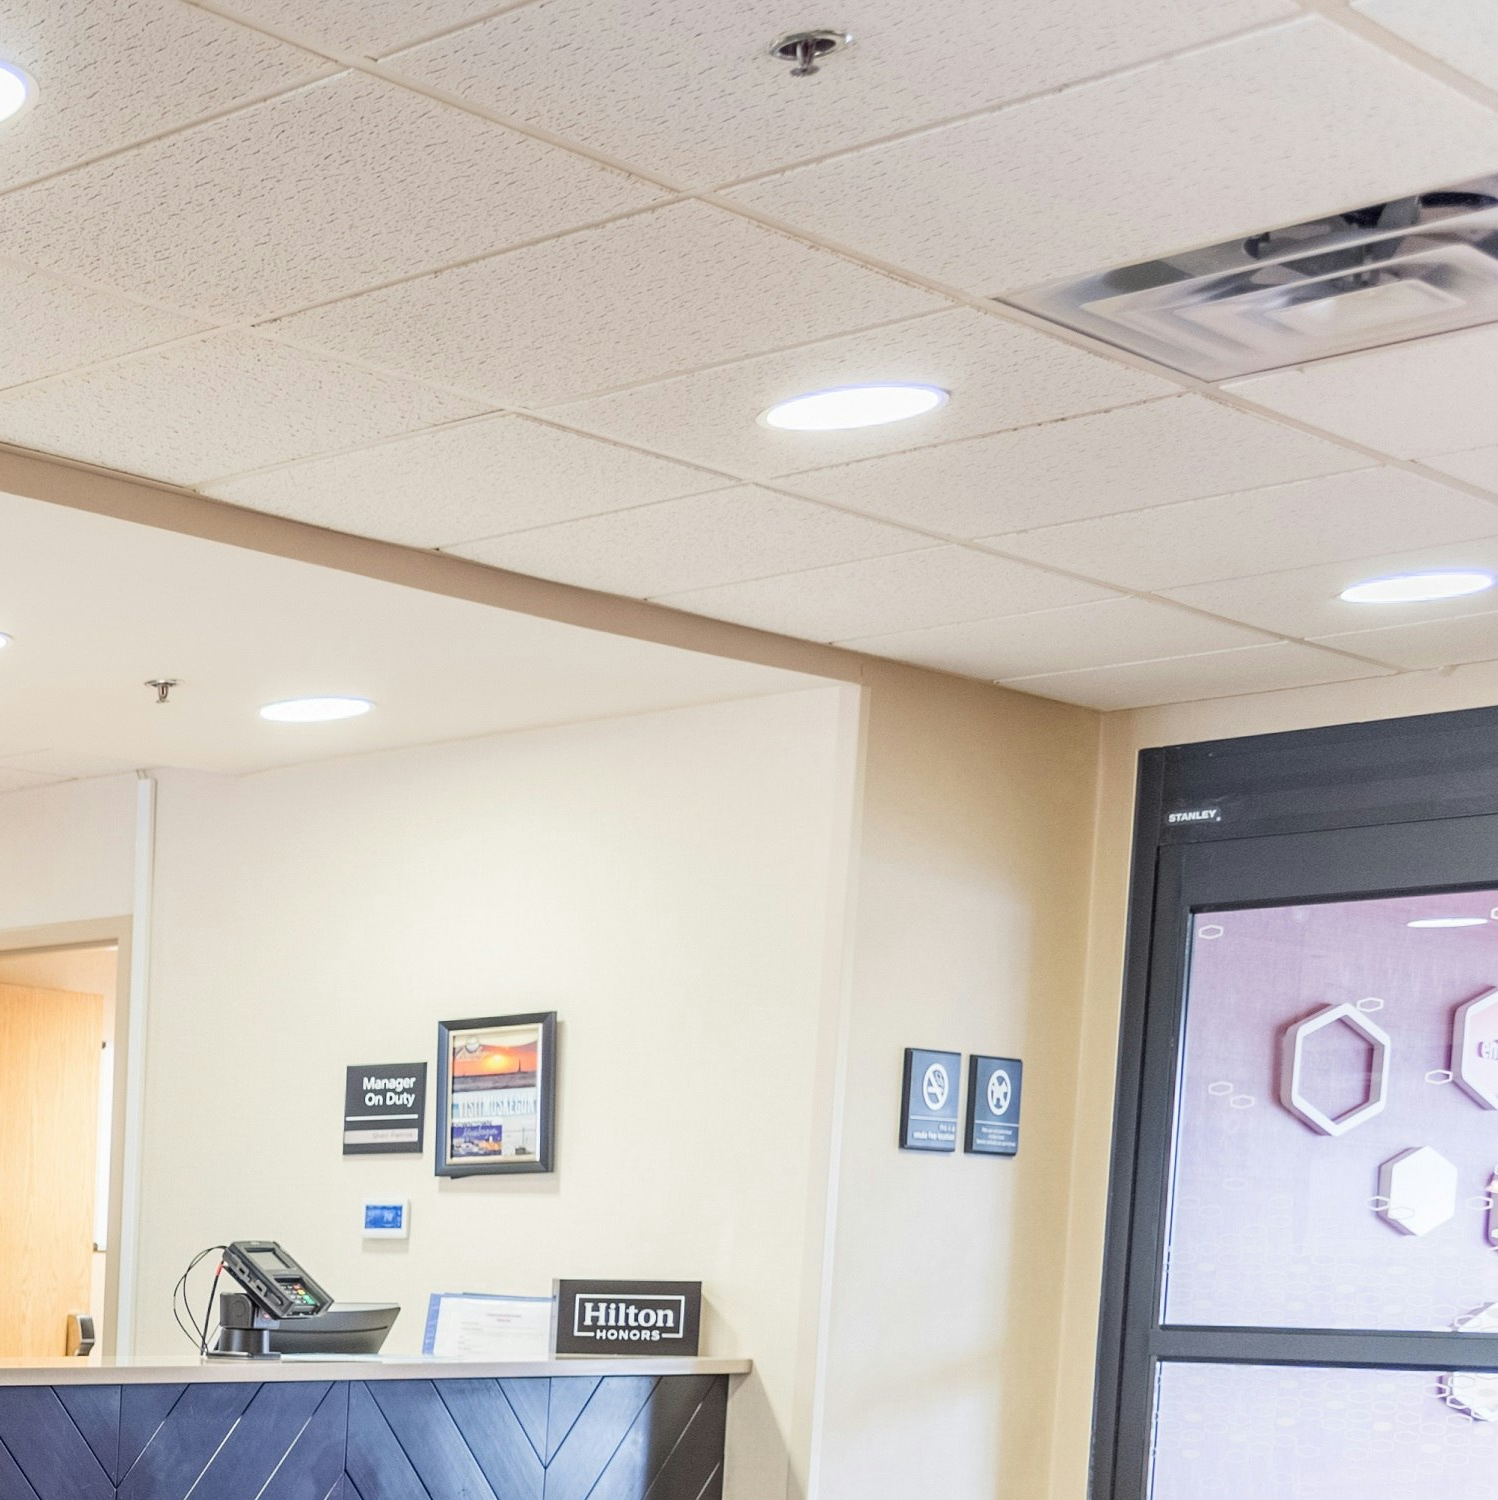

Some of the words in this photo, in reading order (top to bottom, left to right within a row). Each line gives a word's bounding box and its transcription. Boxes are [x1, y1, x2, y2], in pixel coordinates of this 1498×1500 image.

[1168, 809, 1217, 823] STANLEY
[362, 1076, 416, 1092] Manager
[364, 1092, 383, 1106] On
[386, 1091, 415, 1107] Duty
[583, 1301, 675, 1328] Hilton
[595, 1328, 661, 1342] HONORS
